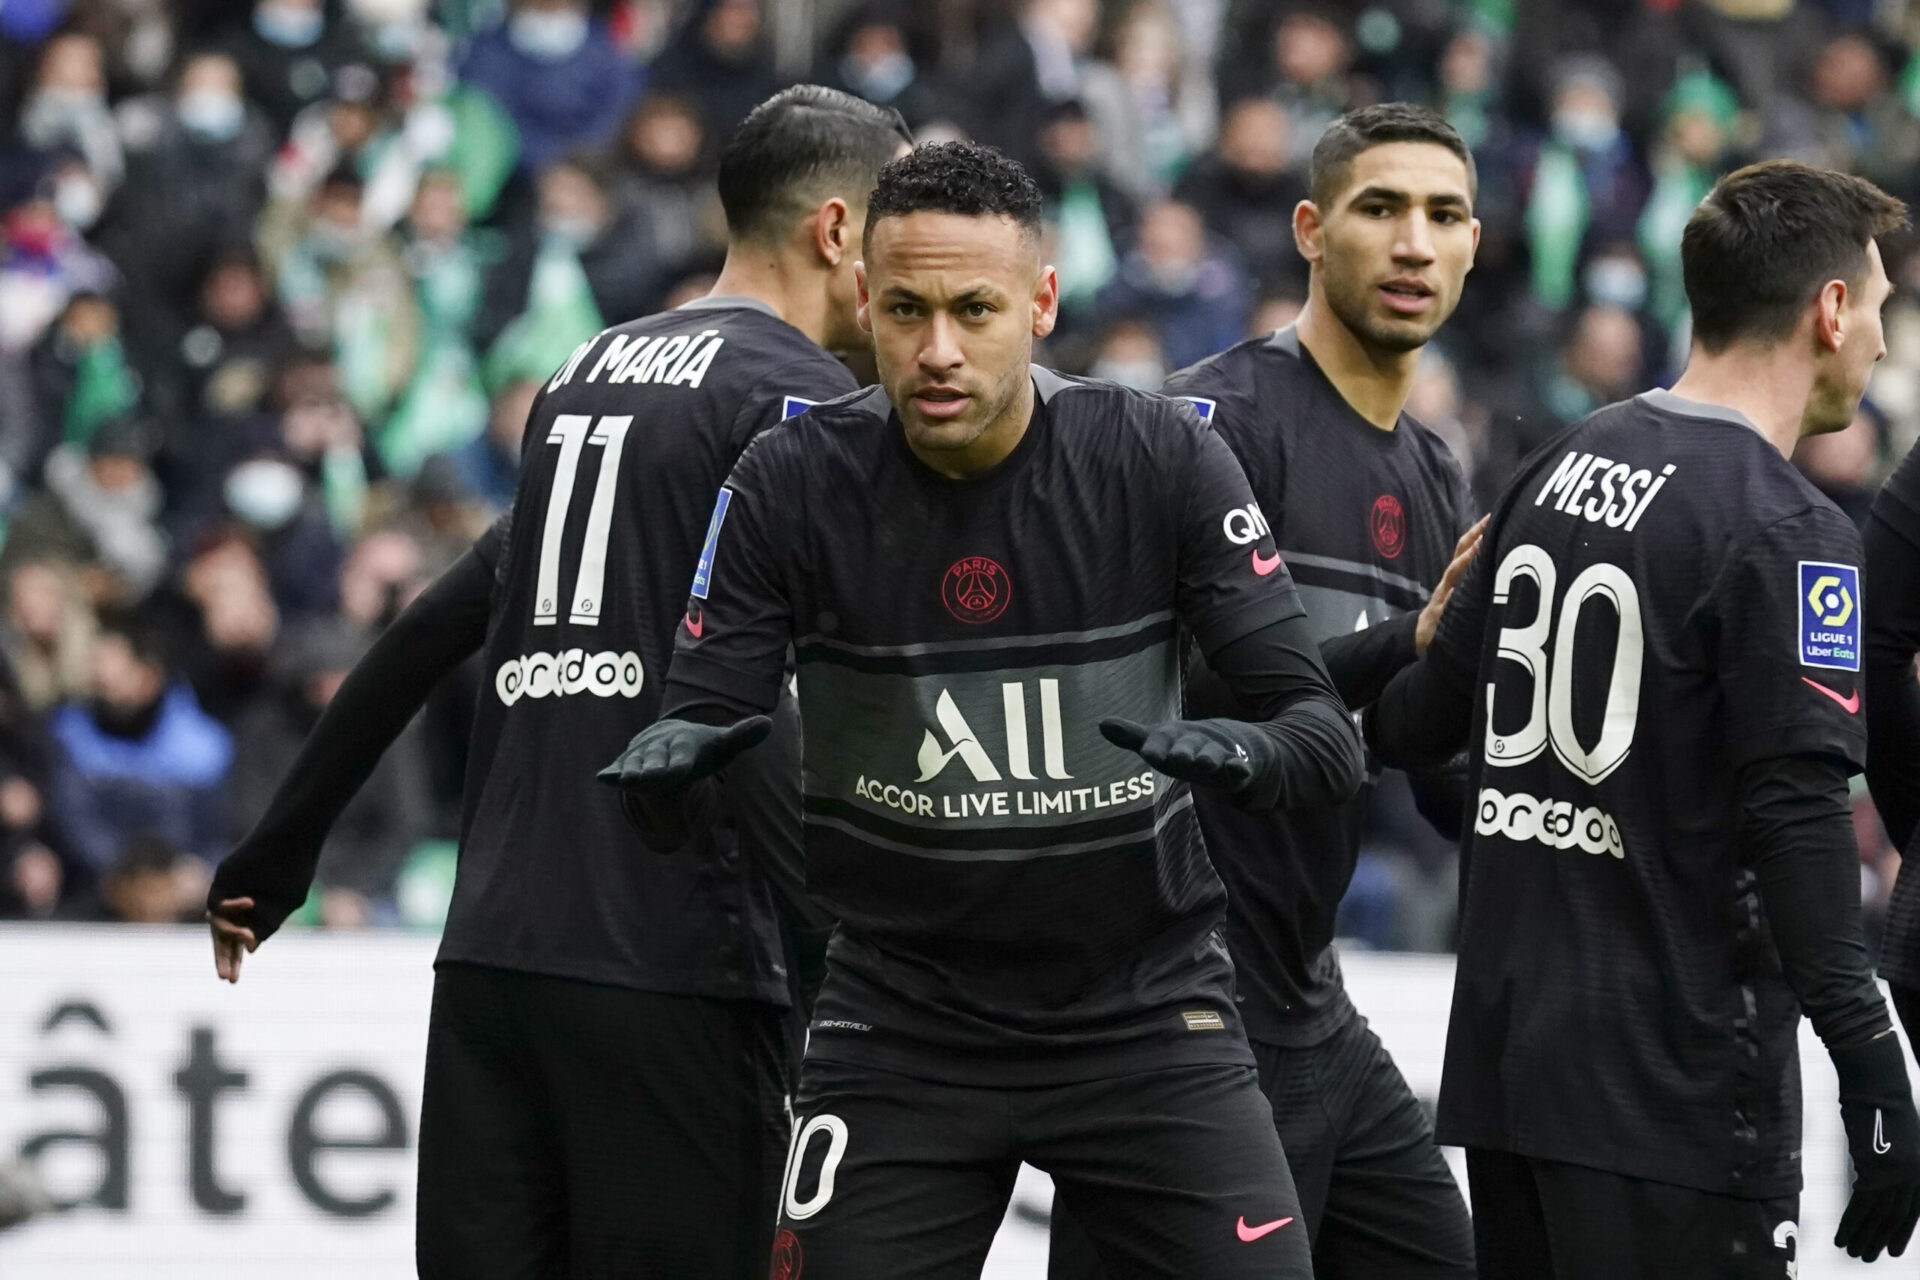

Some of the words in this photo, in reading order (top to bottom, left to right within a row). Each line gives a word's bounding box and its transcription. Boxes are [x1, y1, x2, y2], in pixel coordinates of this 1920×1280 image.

[533, 415, 634, 626] 11
[952, 560, 998, 577] PARIS
[1806, 645, 1832, 657] Uber
[1833, 647, 1856, 660] Eats
[1810, 631, 1846, 645] LIGUE
[1846, 635, 1853, 646] 1
[1485, 544, 1644, 786] 30
[855, 775, 936, 818] ACCOR
[943, 792, 1010, 818] LIVE
[1017, 772, 1155, 815] LIMITLESS
